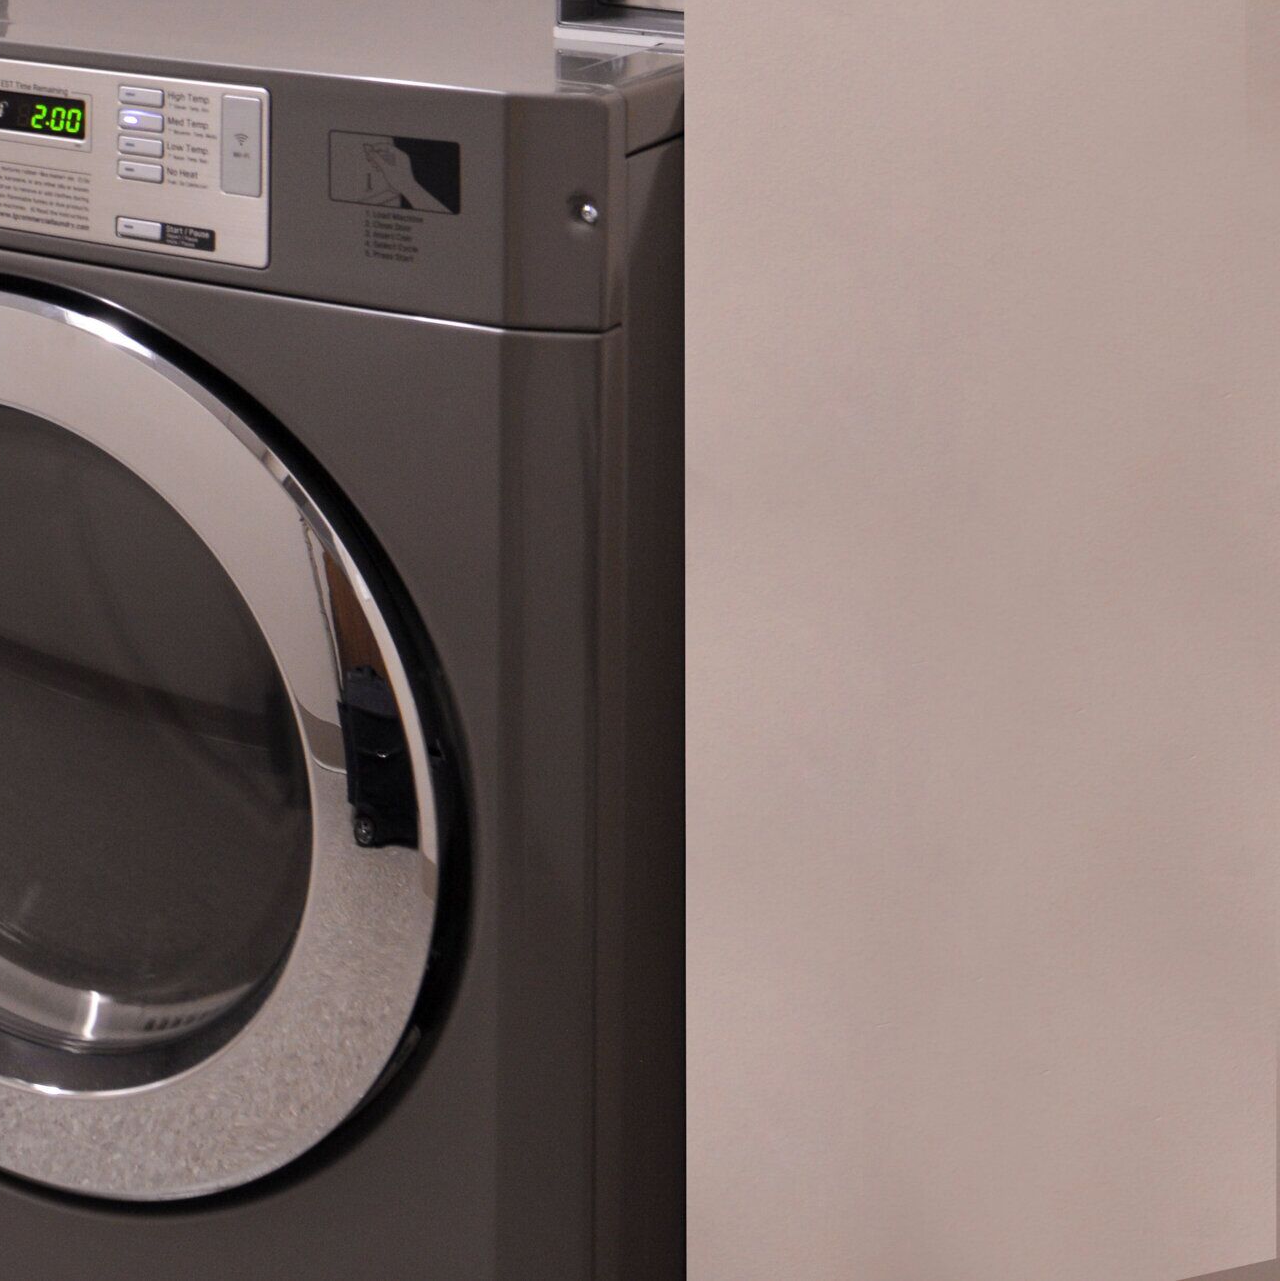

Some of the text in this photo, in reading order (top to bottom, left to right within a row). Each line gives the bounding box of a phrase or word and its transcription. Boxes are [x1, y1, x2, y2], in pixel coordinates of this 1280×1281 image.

[1, 79, 68, 96] EST Time Remaining
[167, 91, 210, 105] High Temp
[167, 117, 209, 130] Med Temp
[167, 143, 209, 156] Low Temp
[167, 168, 199, 180] No Heat
[166, 224, 183, 236] Start
[189, 227, 210, 239] Pause
